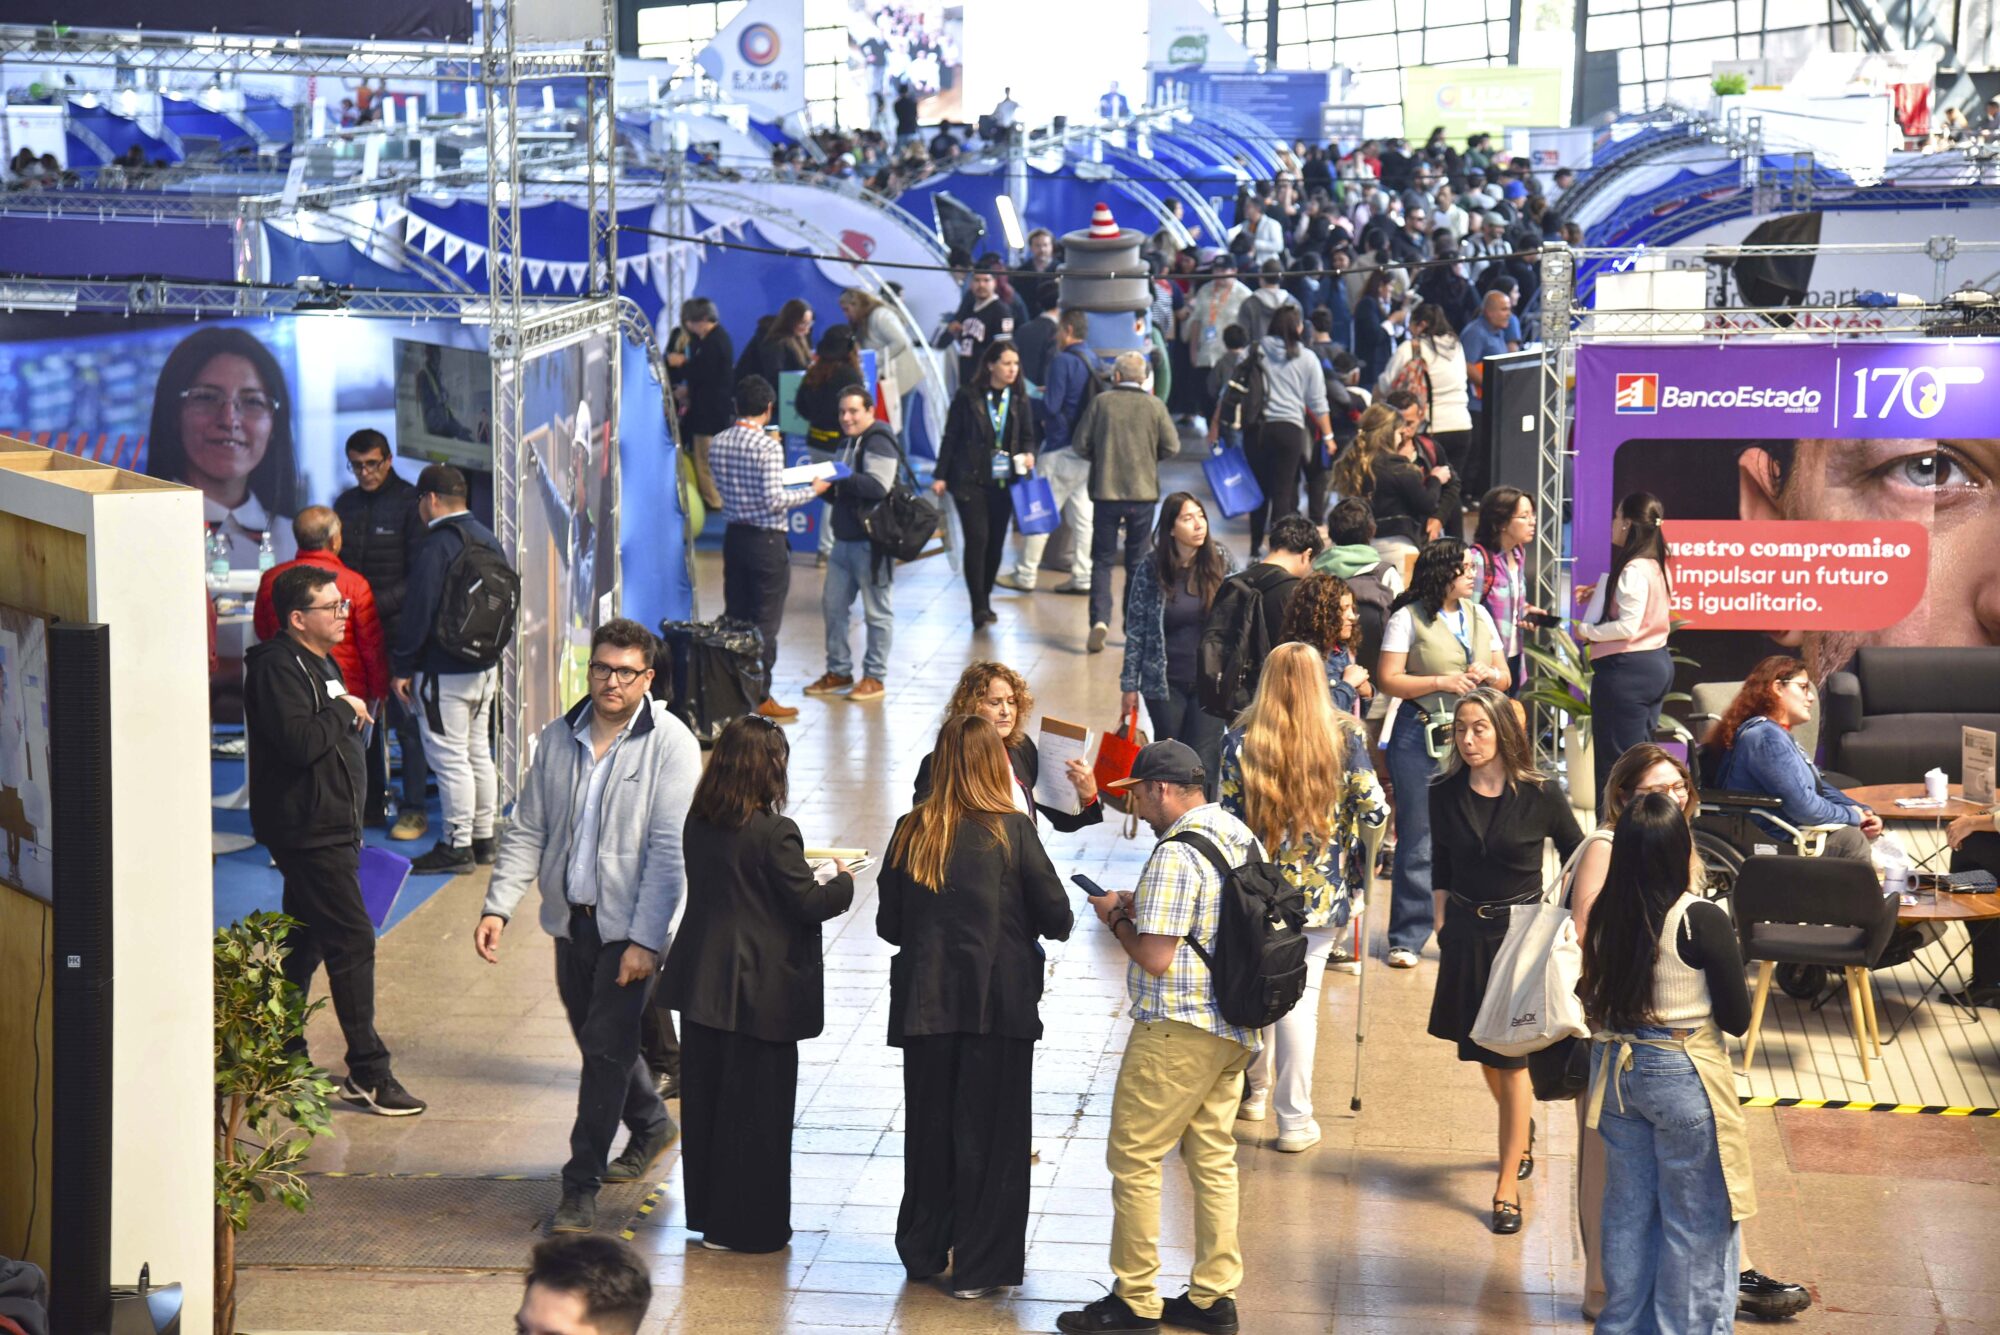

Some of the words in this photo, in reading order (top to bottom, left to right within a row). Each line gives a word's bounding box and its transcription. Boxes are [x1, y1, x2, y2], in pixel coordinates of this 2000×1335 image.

[1661, 386, 1821, 408] BancoEstado
[1852, 366, 1946, 419] 170
[1667, 540, 1745, 557] uestro
[1750, 537, 1911, 562] compromiso
[1676, 564, 1776, 587] impulsar
[1781, 569, 1810, 584] un
[1816, 566, 1889, 585] futuro
[1669, 591, 1693, 610] ás
[1698, 591, 1823, 615] igualitario.
